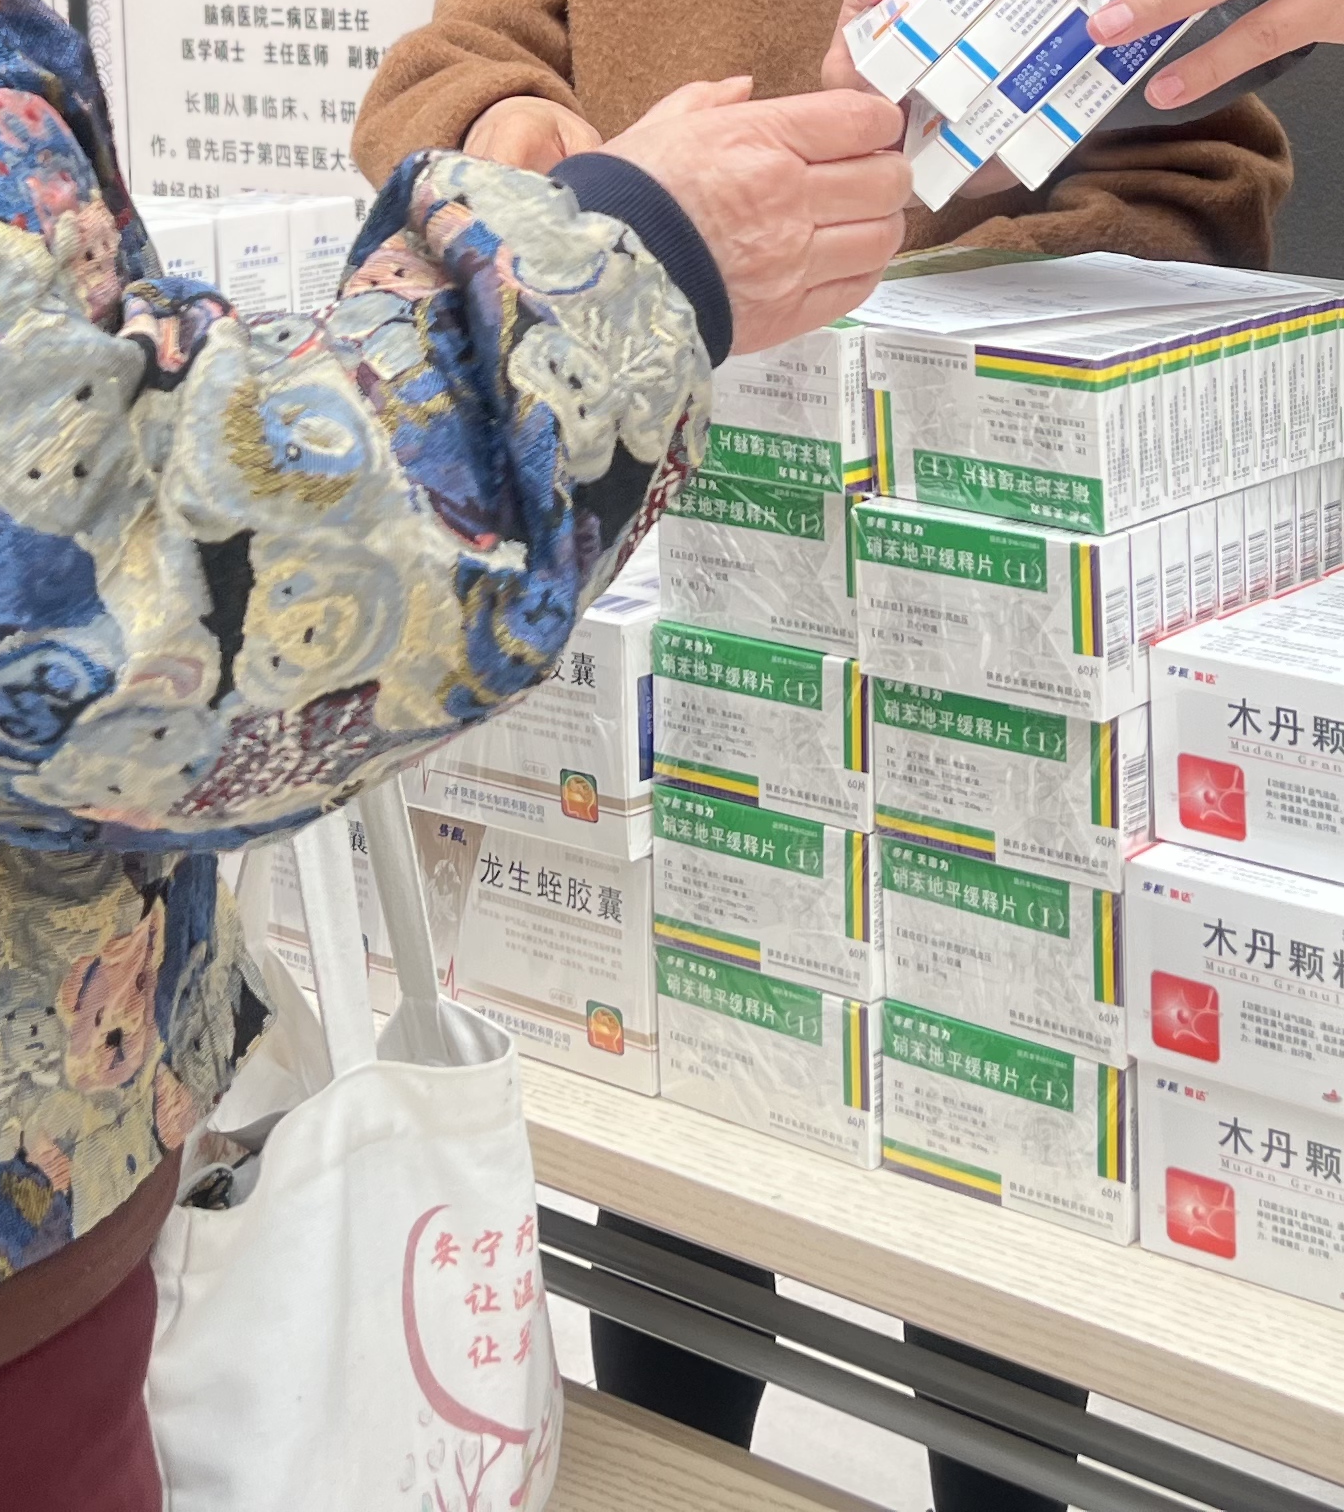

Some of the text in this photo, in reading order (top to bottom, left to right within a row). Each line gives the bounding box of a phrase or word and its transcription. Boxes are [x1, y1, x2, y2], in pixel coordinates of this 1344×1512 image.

[205, 3, 371, 32] 脑病医院二病区副主任
[181, 37, 387, 70] 医学硕士 主任医师 副教
[1125, 48, 1149, 72] 2027
[1011, 61, 1036, 87] 2025
[1025, 75, 1050, 100] 2027
[1229, 740, 1285, 761] Mudan
[479, 851, 624, 924] 龙生蛭胶囊
[1204, 958, 1261, 985] Mudan
[1220, 1156, 1278, 1185] Mudan
[464, 1269, 547, 1316] 让温
